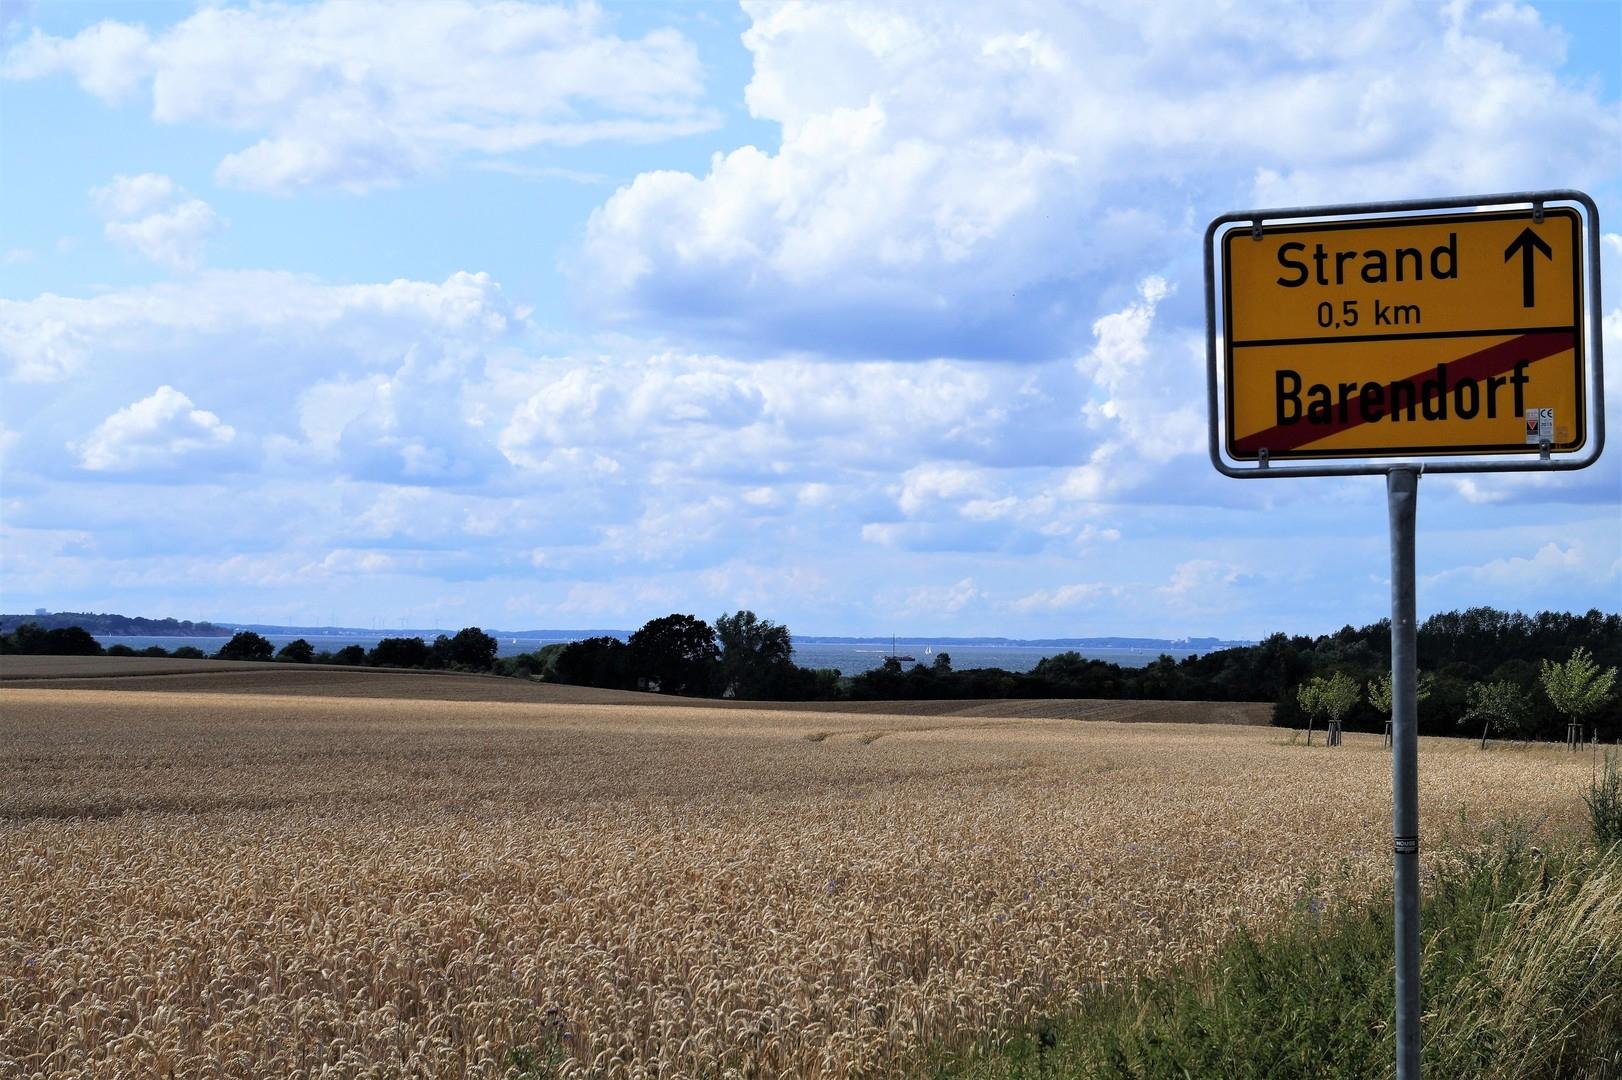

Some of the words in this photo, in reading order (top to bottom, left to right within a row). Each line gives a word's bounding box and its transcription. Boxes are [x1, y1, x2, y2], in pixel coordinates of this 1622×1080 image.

[1277, 232, 1458, 288] Strand
[1317, 301, 1358, 328] 0,5
[1375, 300, 1420, 325] km
[1276, 361, 1530, 427] Barendorf
